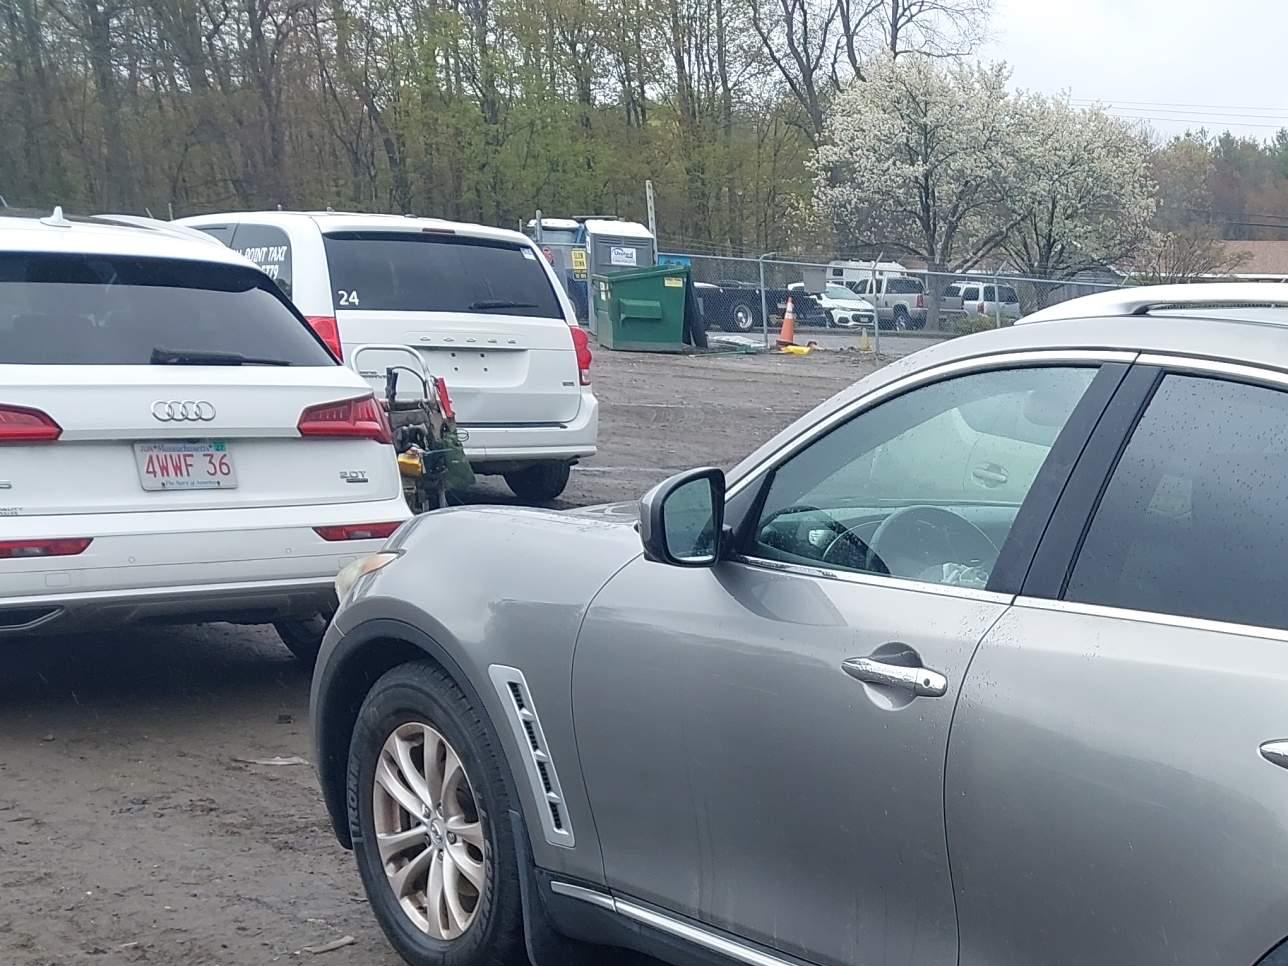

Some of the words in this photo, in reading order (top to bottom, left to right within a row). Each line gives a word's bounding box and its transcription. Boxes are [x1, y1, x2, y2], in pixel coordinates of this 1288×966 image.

[268, 245, 288, 262] TAXI
[338, 290, 359, 306] 24
[145, 453, 194, 479] 4WWF
[203, 453, 231, 476] 36
